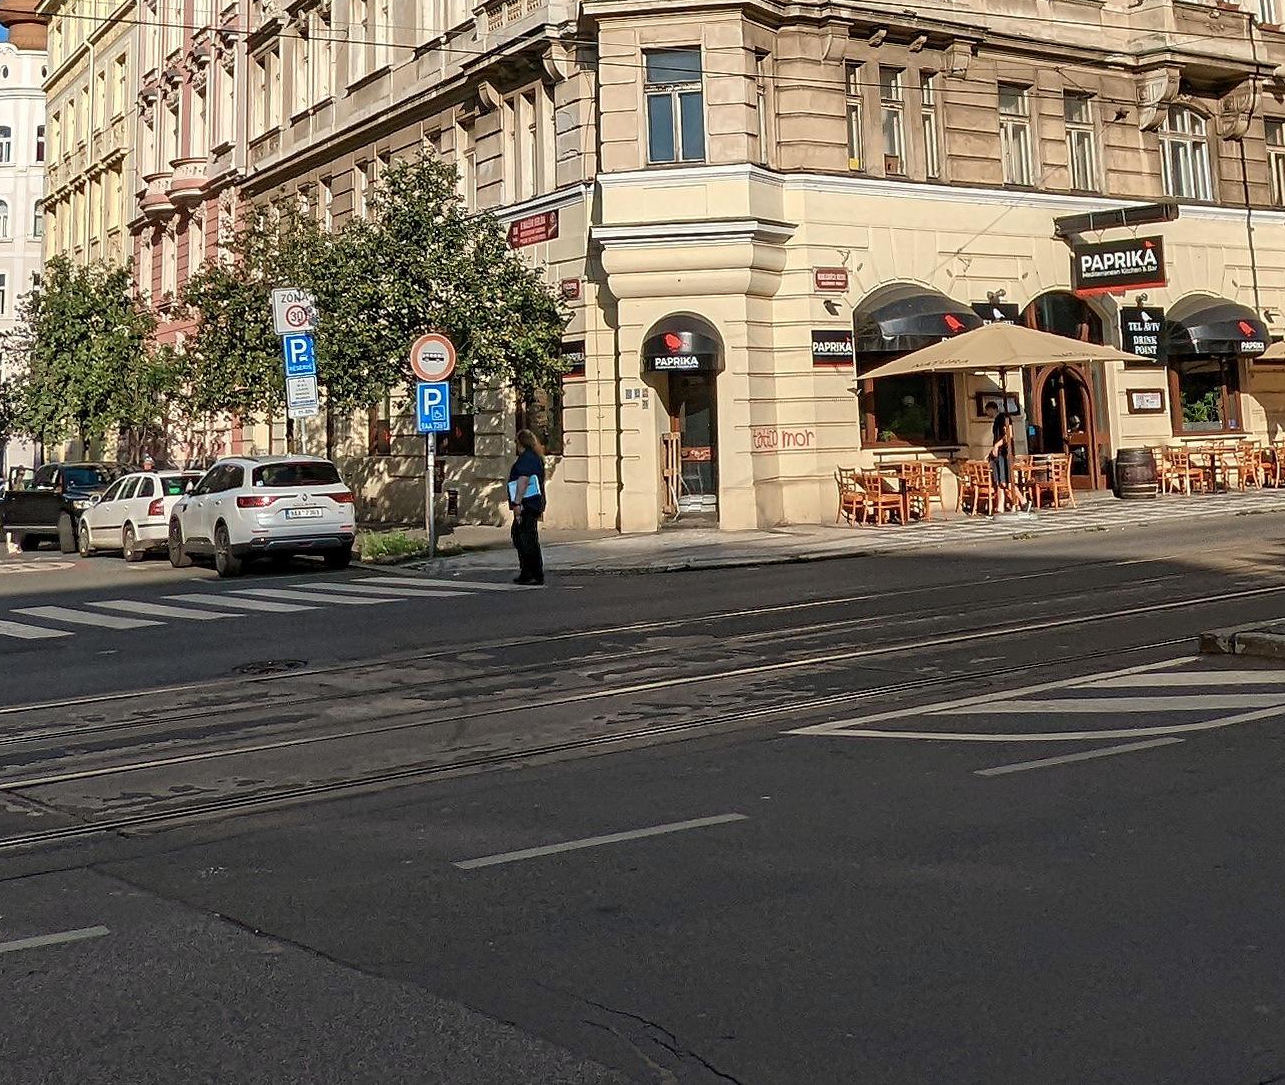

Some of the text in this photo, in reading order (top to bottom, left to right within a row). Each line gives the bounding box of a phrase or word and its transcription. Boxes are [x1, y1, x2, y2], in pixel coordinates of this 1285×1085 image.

[1081, 248, 1157, 272] PAPRIKA
[1082, 269, 1120, 279] Mediterranean
[1121, 266, 1142, 275] Kitchen
[290, 310, 304, 322] 30
[1128, 322, 1160, 331] TEL AVIV
[1133, 335, 1158, 345] DRINK
[1241, 341, 1264, 349] PAPRIKA
[290, 339, 307, 364] P
[813, 341, 852, 352] PAPRIKA
[1134, 345, 1157, 355] POINT
[655, 356, 699, 366] PAPRIKA
[424, 388, 442, 415] P
[781, 429, 814, 448] mor
